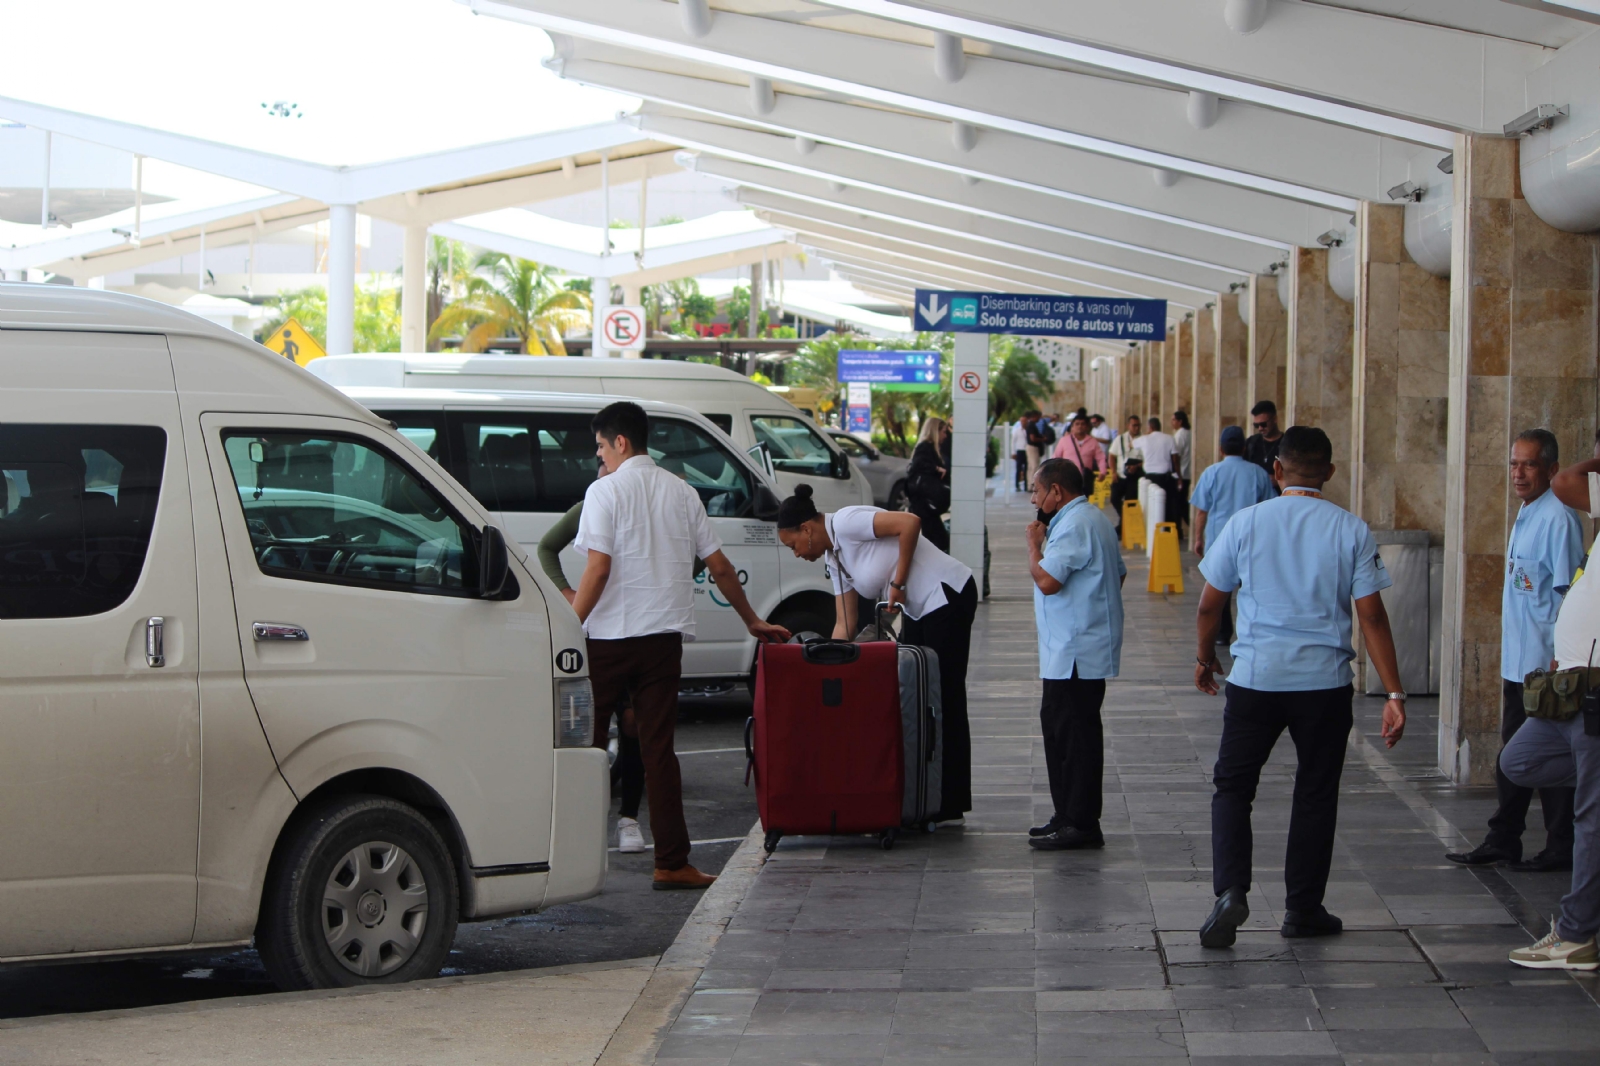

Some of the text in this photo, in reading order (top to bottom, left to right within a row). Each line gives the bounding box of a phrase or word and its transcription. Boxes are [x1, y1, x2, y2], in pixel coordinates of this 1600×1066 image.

[981, 295, 1135, 319] Disembarking cars & vans only
[615, 317, 630, 339] E
[980, 312, 1154, 335] Solo descenso de autos y vans
[965, 375, 974, 389] E
[562, 652, 578, 670] 01
